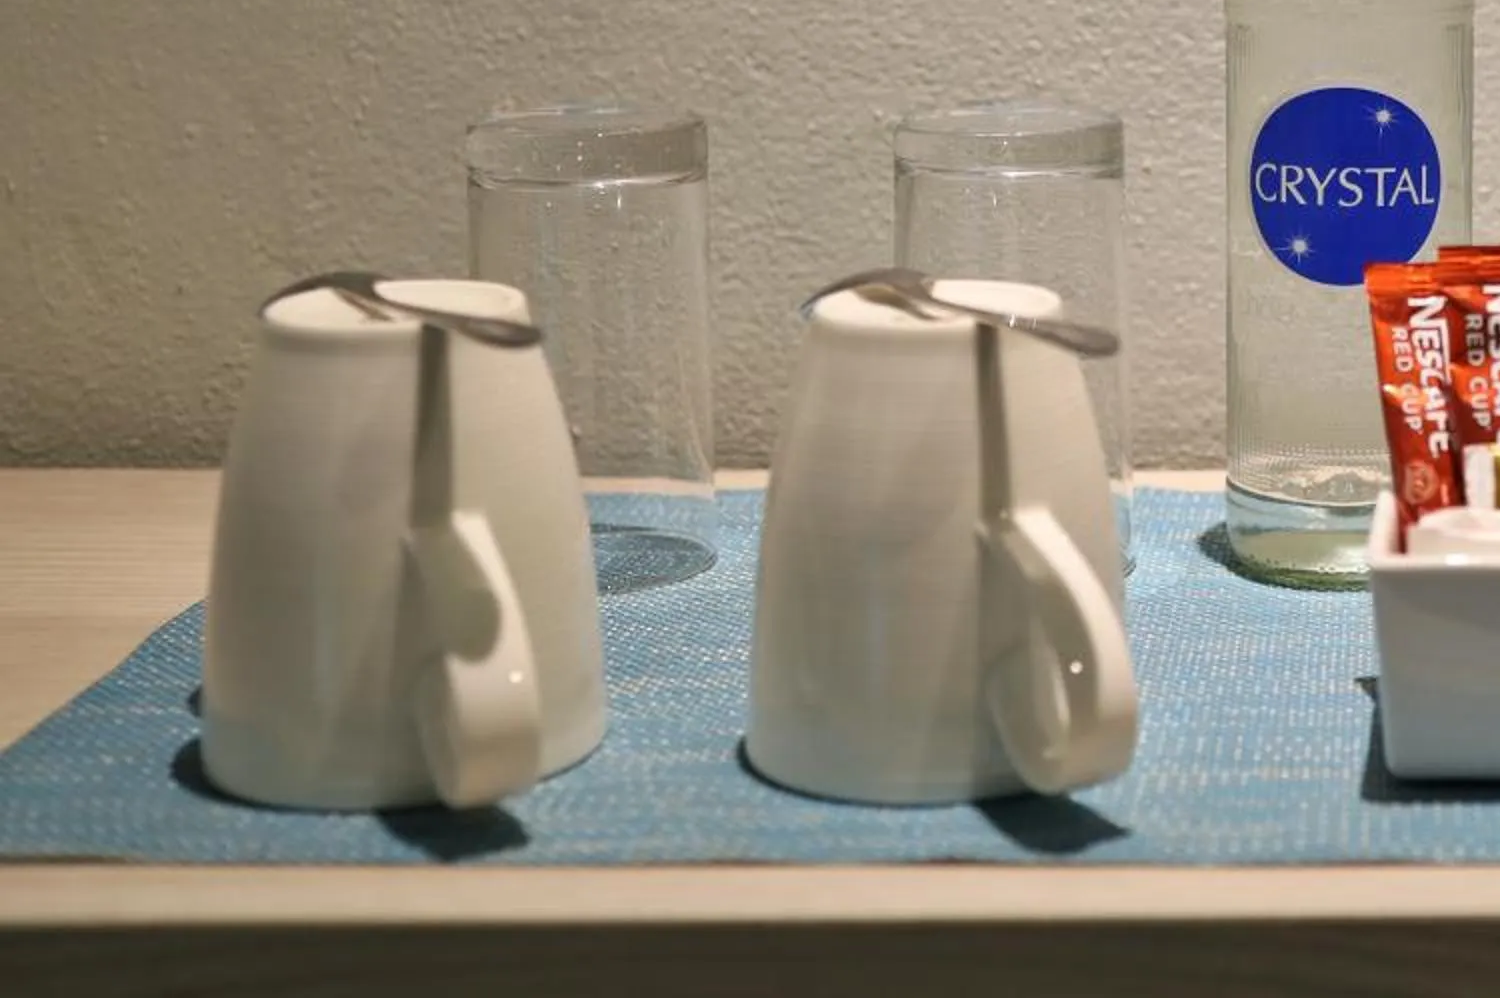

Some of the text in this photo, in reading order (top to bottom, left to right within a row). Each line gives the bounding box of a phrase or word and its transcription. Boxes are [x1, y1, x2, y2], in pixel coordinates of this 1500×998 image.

[1255, 163, 1435, 207] CRYSTAL
[1391, 326, 1424, 430] RED CUP
[1464, 313, 1491, 427] RED CUP
